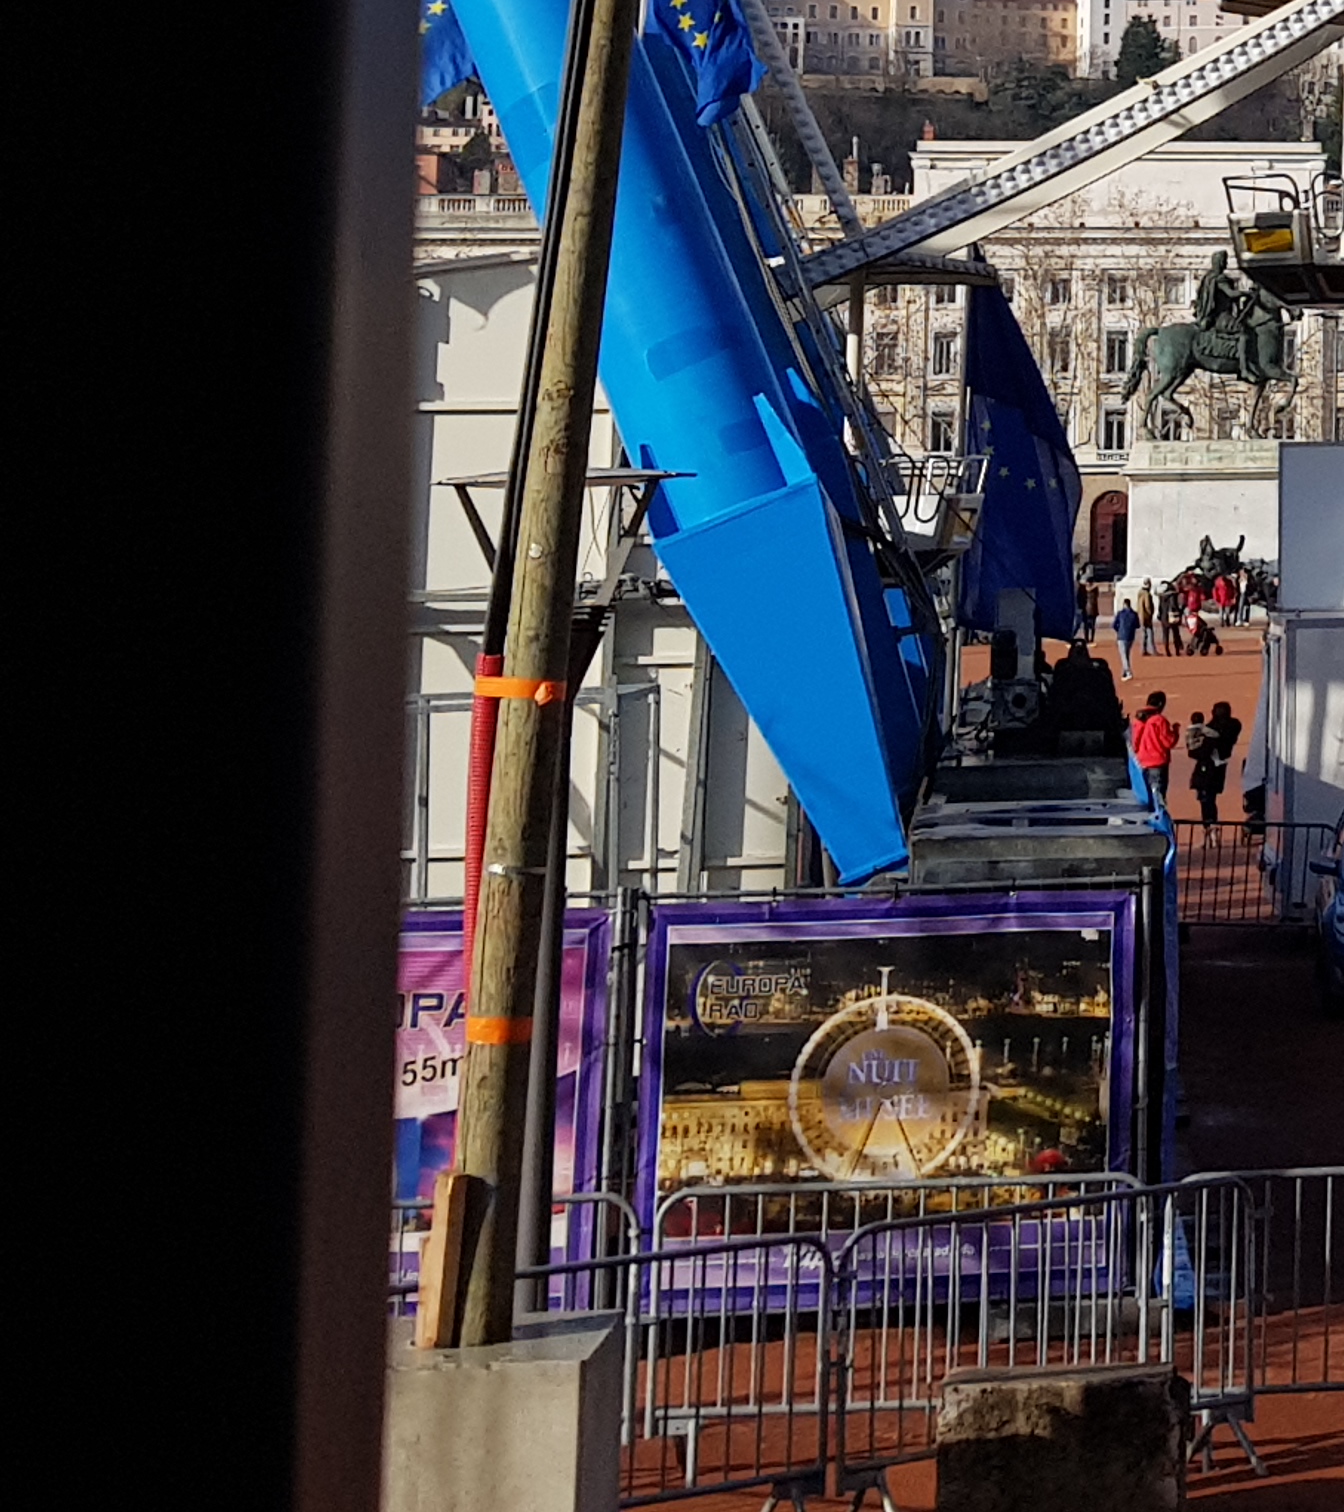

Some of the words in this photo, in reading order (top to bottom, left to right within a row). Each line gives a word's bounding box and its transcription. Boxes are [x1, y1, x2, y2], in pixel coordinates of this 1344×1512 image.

[709, 974, 807, 996] EUROPA
[708, 999, 761, 1021] RAD
[849, 1059, 920, 1085] NUIT
